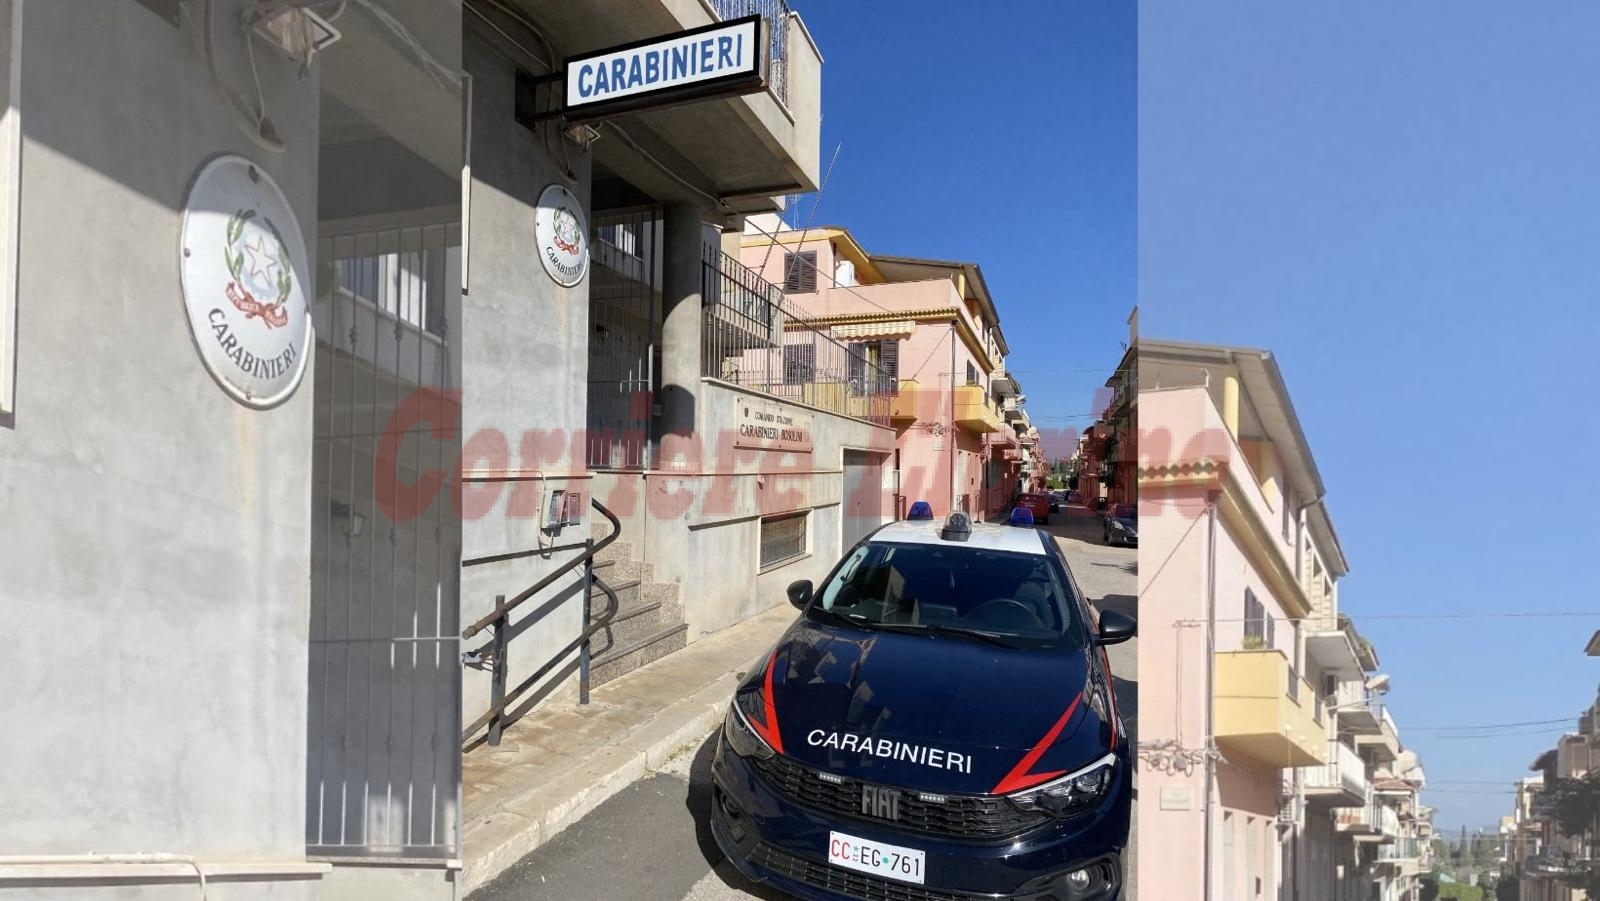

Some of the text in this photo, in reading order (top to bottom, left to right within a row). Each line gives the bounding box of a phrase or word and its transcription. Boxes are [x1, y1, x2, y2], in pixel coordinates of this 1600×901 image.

[579, 33, 743, 98] CARABINIERI
[208, 308, 297, 380] CARABINIERI
[740, 424, 803, 442] CARABINIERI ROSOLINI
[755, 411, 775, 423] COMANDO
[807, 729, 973, 774] CARABINIERI
[862, 785, 901, 821] FIAT
[831, 839, 851, 860] CC
[861, 846, 881, 867] EG
[891, 853, 920, 877] 761
